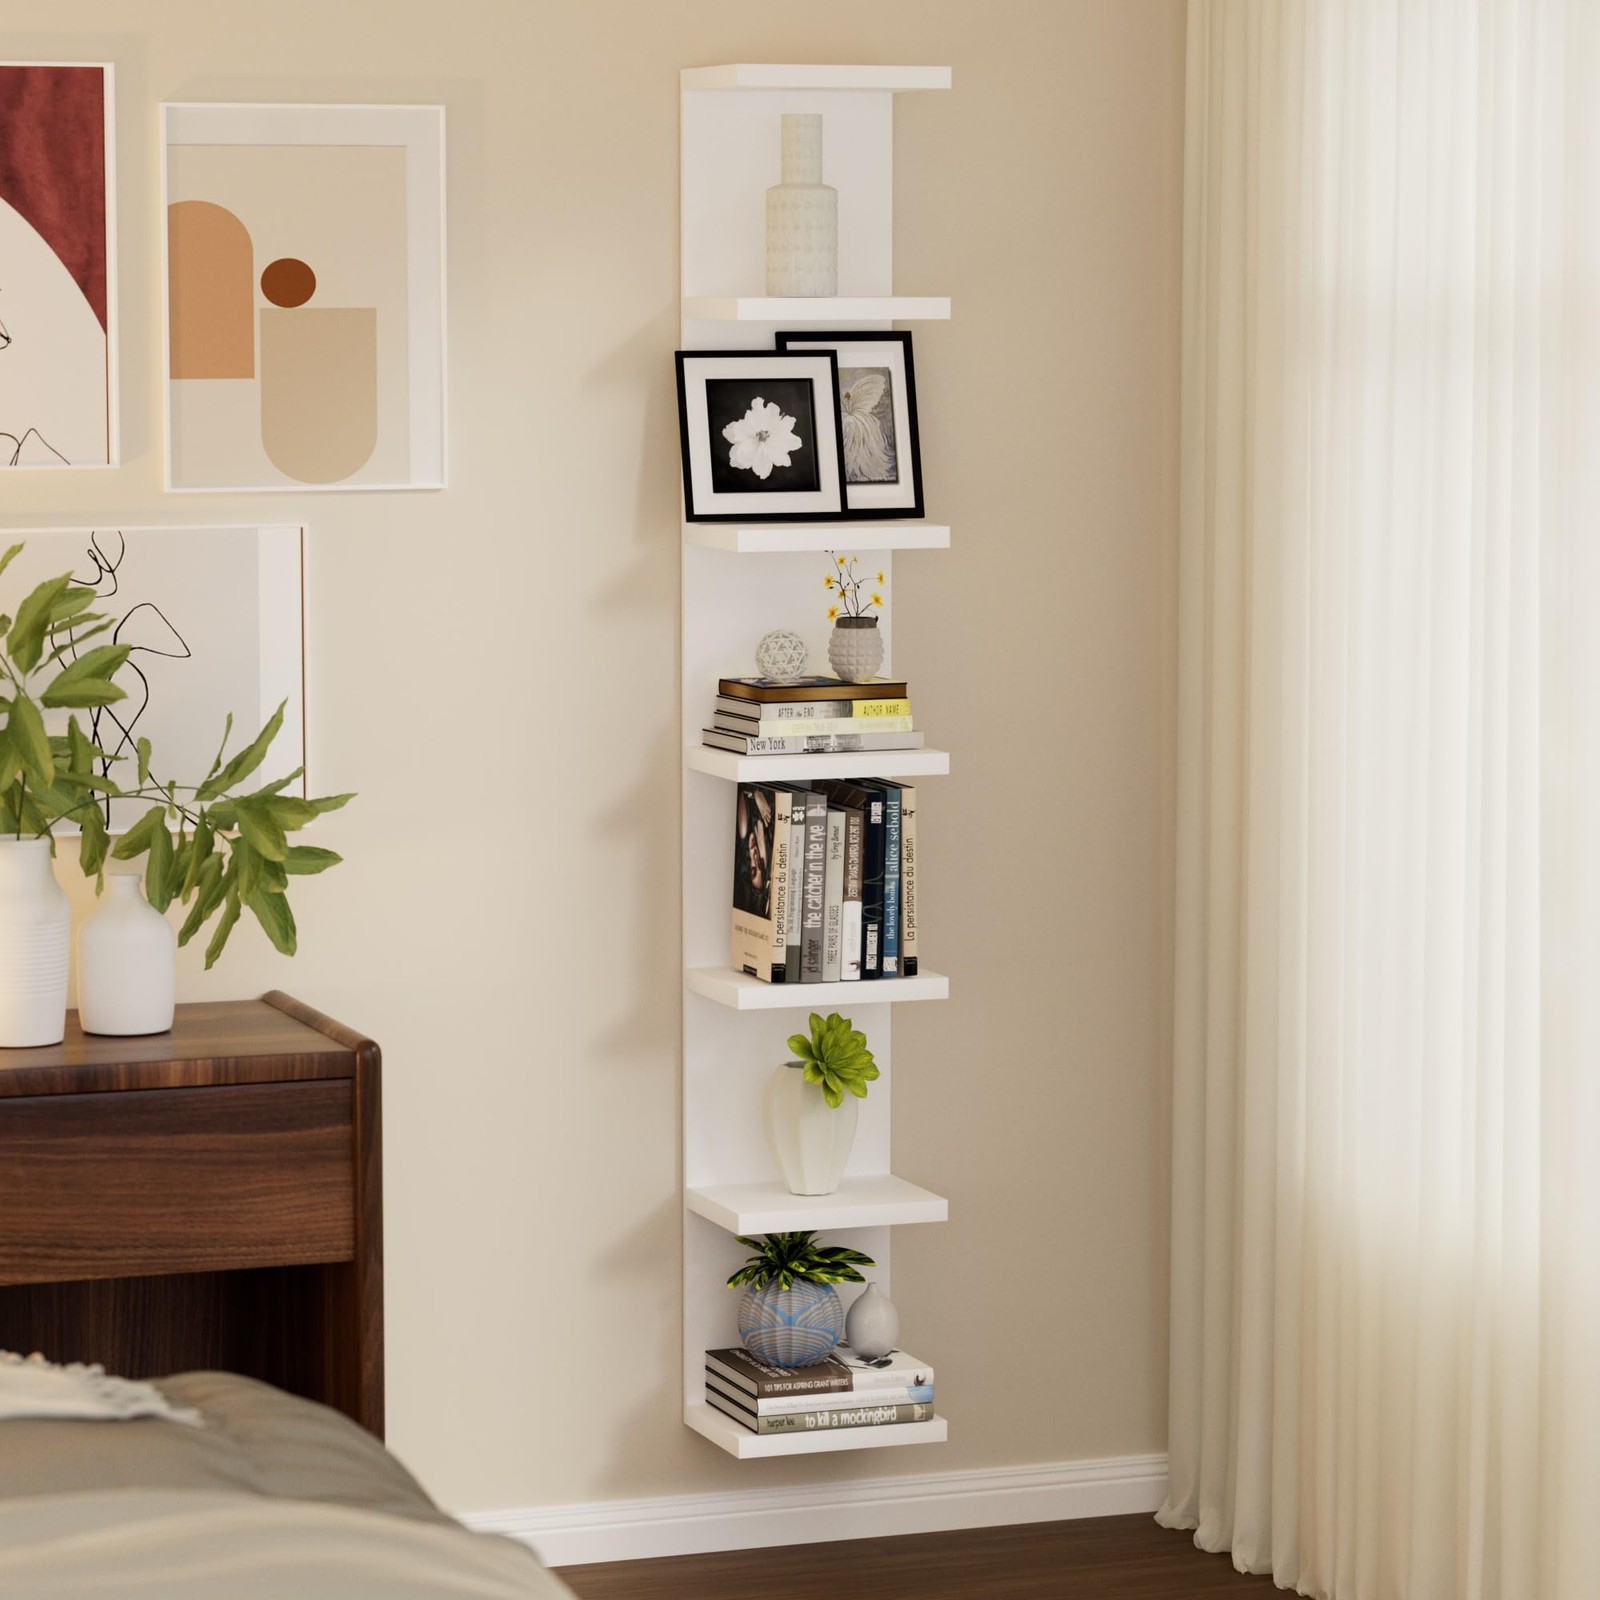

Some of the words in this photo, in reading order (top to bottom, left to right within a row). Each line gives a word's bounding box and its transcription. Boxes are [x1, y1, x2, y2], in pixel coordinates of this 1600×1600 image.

[778, 708, 793, 717] AFTER
[804, 707, 814, 717] END
[864, 705, 882, 716] AUTHOR
[886, 704, 900, 715] NAME
[750, 738, 766, 750] New
[768, 737, 786, 750] York
[887, 801, 899, 840] sebold
[809, 825, 826, 841] rye
[776, 843, 787, 869] destin
[806, 843, 823, 859] the
[885, 843, 899, 871] alice
[904, 838, 914, 863] destin
[804, 862, 823, 871] in
[904, 866, 914, 877] du
[776, 871, 786, 882] du
[806, 873, 823, 910] catcher
[775, 884, 786, 935] persistance
[905, 881, 917, 928] persistance
[804, 912, 821, 928] the
[829, 905, 839, 926] GLASSES
[888, 904, 898, 925] lovely
[887, 927, 895, 939] the
[904, 931, 915, 941] La
[773, 936, 784, 948] La
[828, 935, 838, 949] PAIRS
[804, 939, 819, 965] salinger
[828, 950, 837, 964] THREE
[764, 1384, 773, 1393] 101
[774, 1383, 782, 1392] TIPS
[783, 1382, 792, 1391] FOR
[793, 1380, 813, 1390] ASPIRING
[814, 1379, 830, 1388] GRANT
[830, 1378, 849, 1387] WRITERS
[784, 1416, 796, 1427] lee
[805, 1414, 815, 1428] to
[817, 1412, 830, 1427] kill
[832, 1414, 838, 1425] a
[840, 1406, 897, 1426] mockingbird
